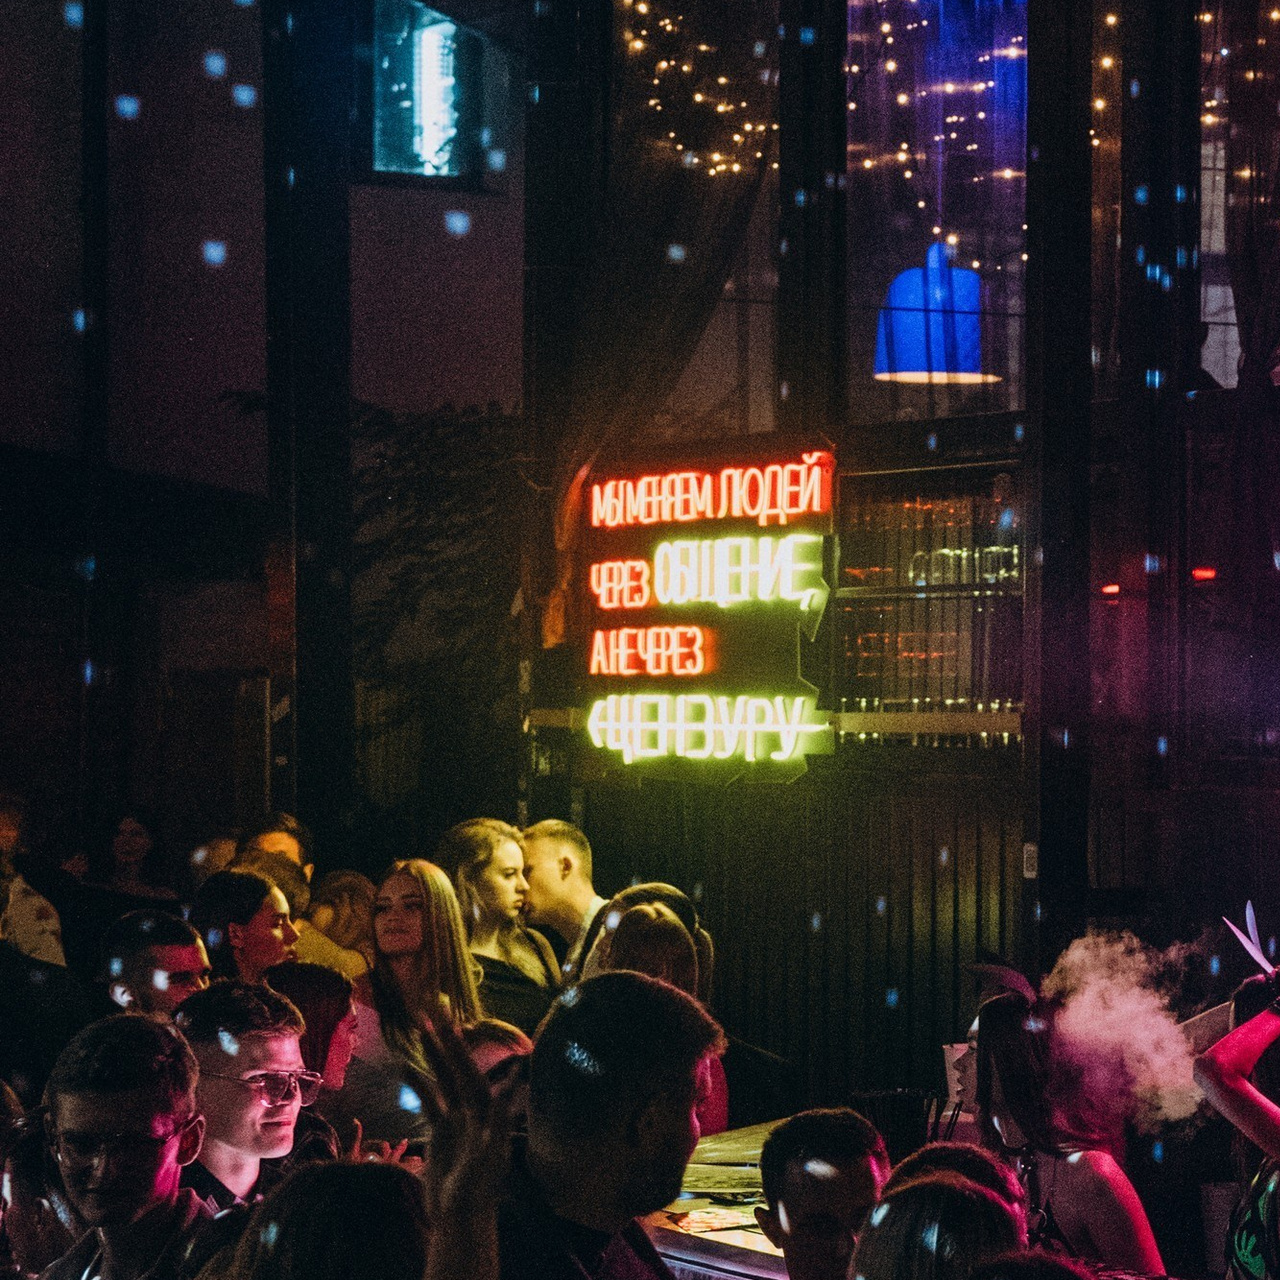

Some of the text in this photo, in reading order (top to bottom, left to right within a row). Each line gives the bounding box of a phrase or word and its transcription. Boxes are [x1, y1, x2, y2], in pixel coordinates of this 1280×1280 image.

[592, 480, 626, 527] МЫ
[626, 472, 715, 525] МЕНЯЕМ
[715, 451, 824, 527] ЛЮДЕЙ
[591, 559, 651, 609] ЧЕРЕЗ
[637, 626, 705, 675] ЧЕРЕЗ
